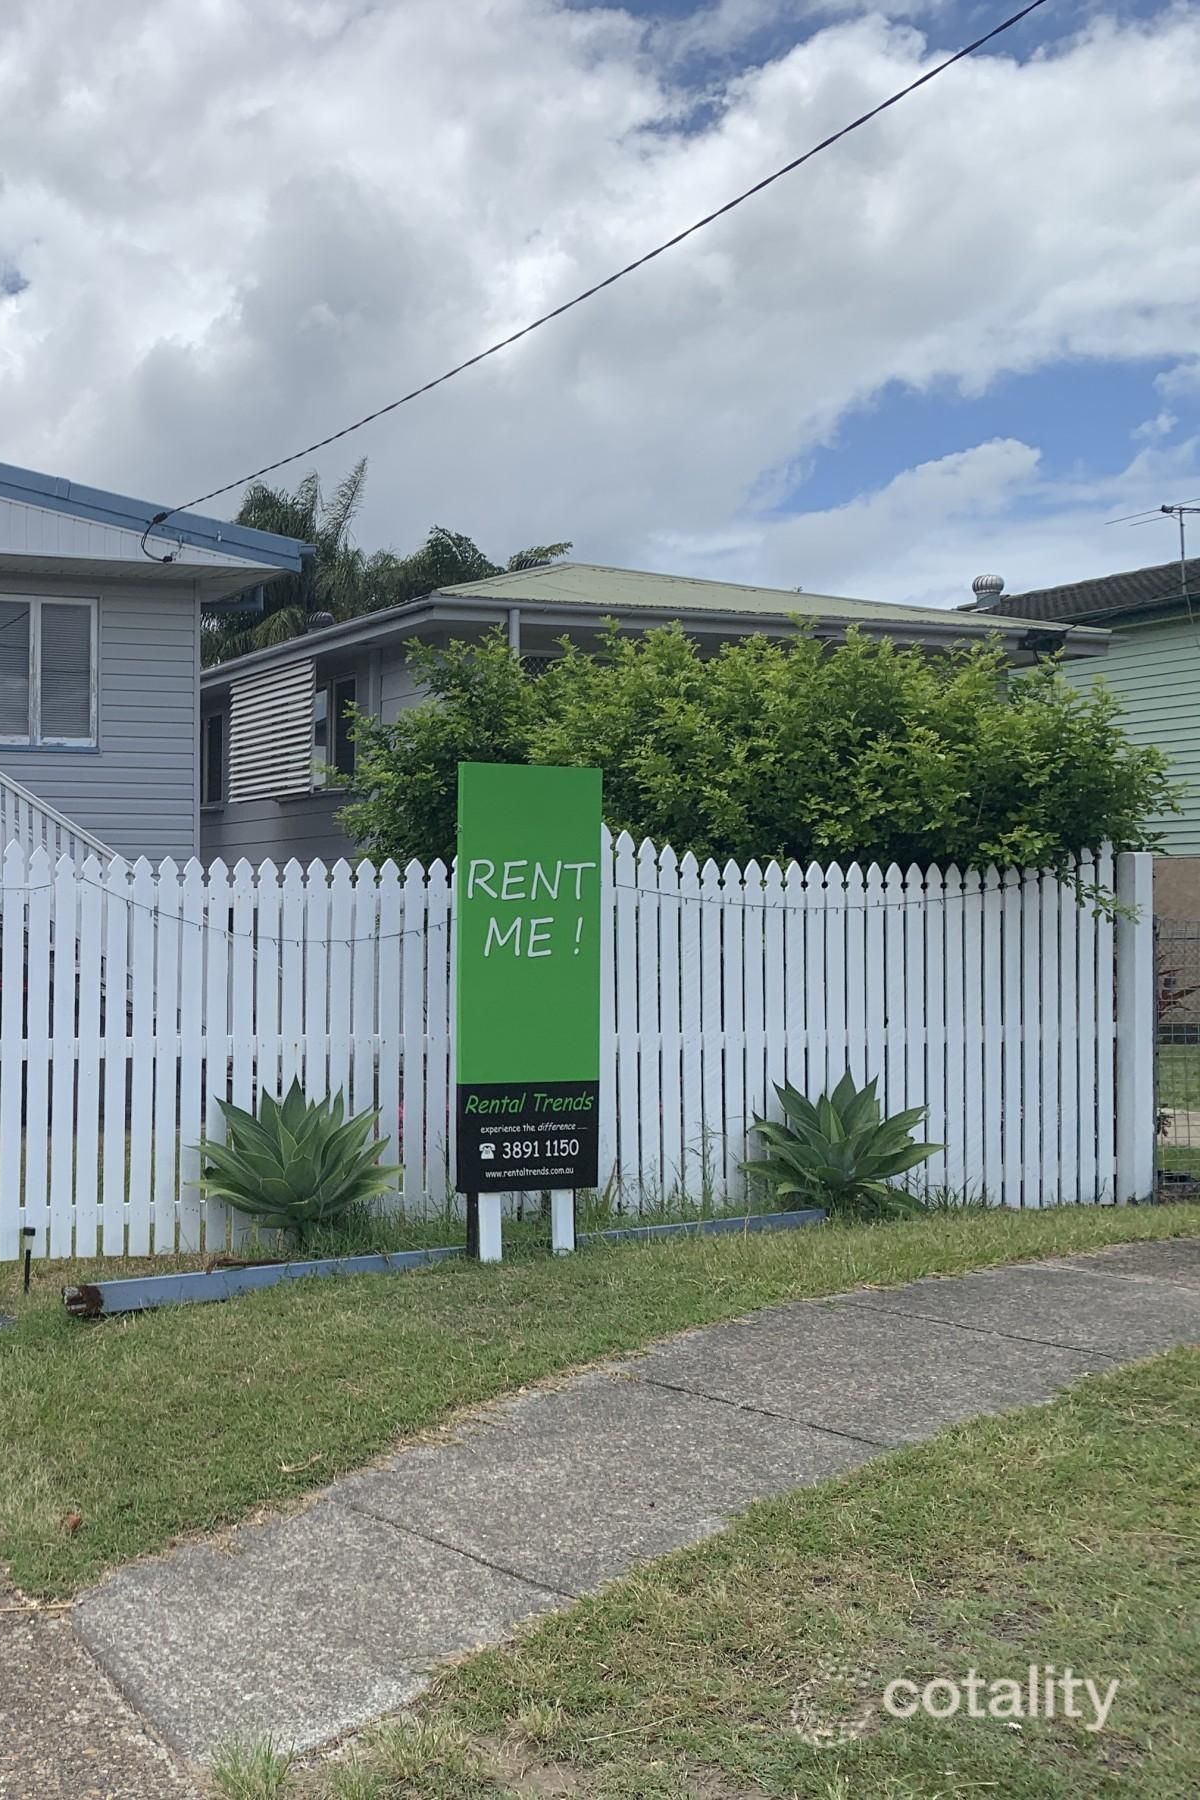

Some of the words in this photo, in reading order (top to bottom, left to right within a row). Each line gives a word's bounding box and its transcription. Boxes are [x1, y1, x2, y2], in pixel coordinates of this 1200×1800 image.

[467, 859, 596, 900] RENT
[484, 916, 554, 957] ME
[464, 1092, 527, 1115] Rental
[533, 1091, 594, 1112] Trends
[480, 1124, 521, 1137] experience
[522, 1123, 536, 1132] the
[502, 1141, 539, 1159] 3891
[545, 1138, 580, 1157] 1150
[485, 1167, 574, 1179] www.rentaltrends.com.au
